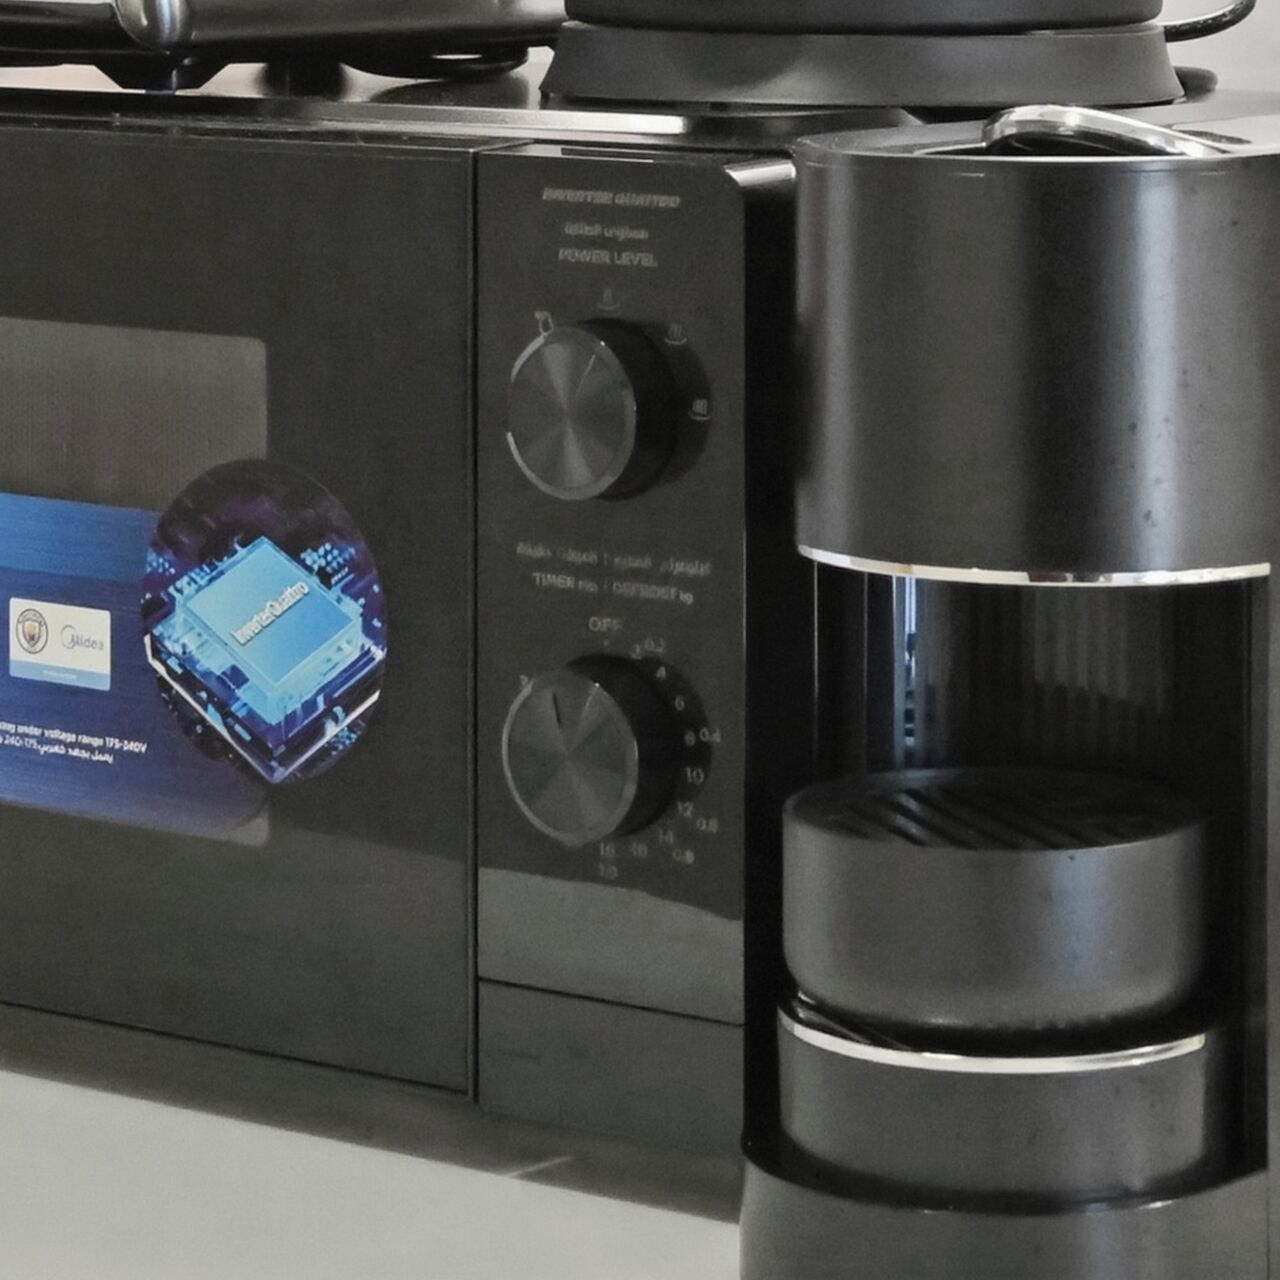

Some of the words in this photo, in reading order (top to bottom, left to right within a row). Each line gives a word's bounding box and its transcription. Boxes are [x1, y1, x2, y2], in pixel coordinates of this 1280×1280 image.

[558, 248, 610, 265] POWER
[614, 251, 658, 267] LEVEL
[532, 572, 575, 589] TIMER
[588, 616, 623, 632] OFF
[17, 723, 43, 736] under
[44, 728, 77, 743] voltage
[78, 733, 104, 748] range
[687, 767, 704, 784] 10
